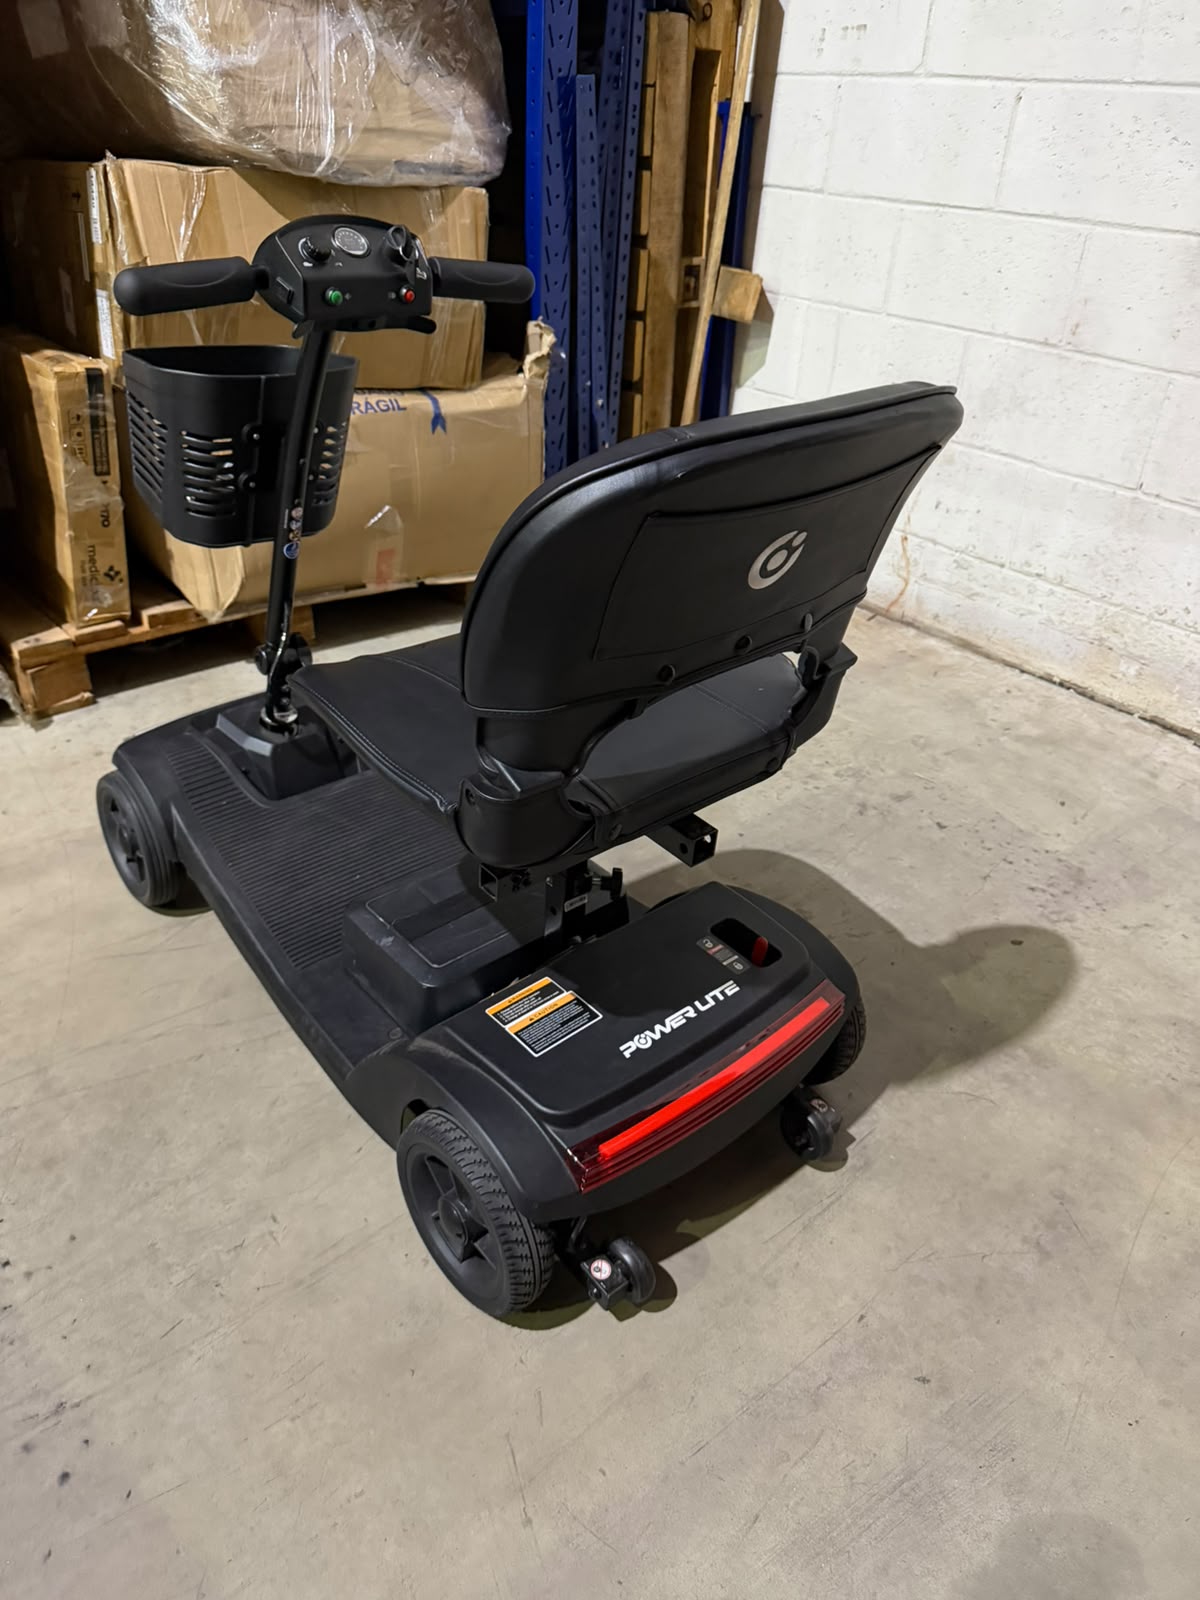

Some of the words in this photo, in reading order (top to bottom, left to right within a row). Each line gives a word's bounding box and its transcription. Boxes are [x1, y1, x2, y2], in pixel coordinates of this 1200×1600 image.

[350, 397, 407, 415] RÁGIL
[533, 1003, 560, 1019] CAUTION
[619, 1005, 698, 1059] POWER
[694, 980, 741, 1012] LITE
